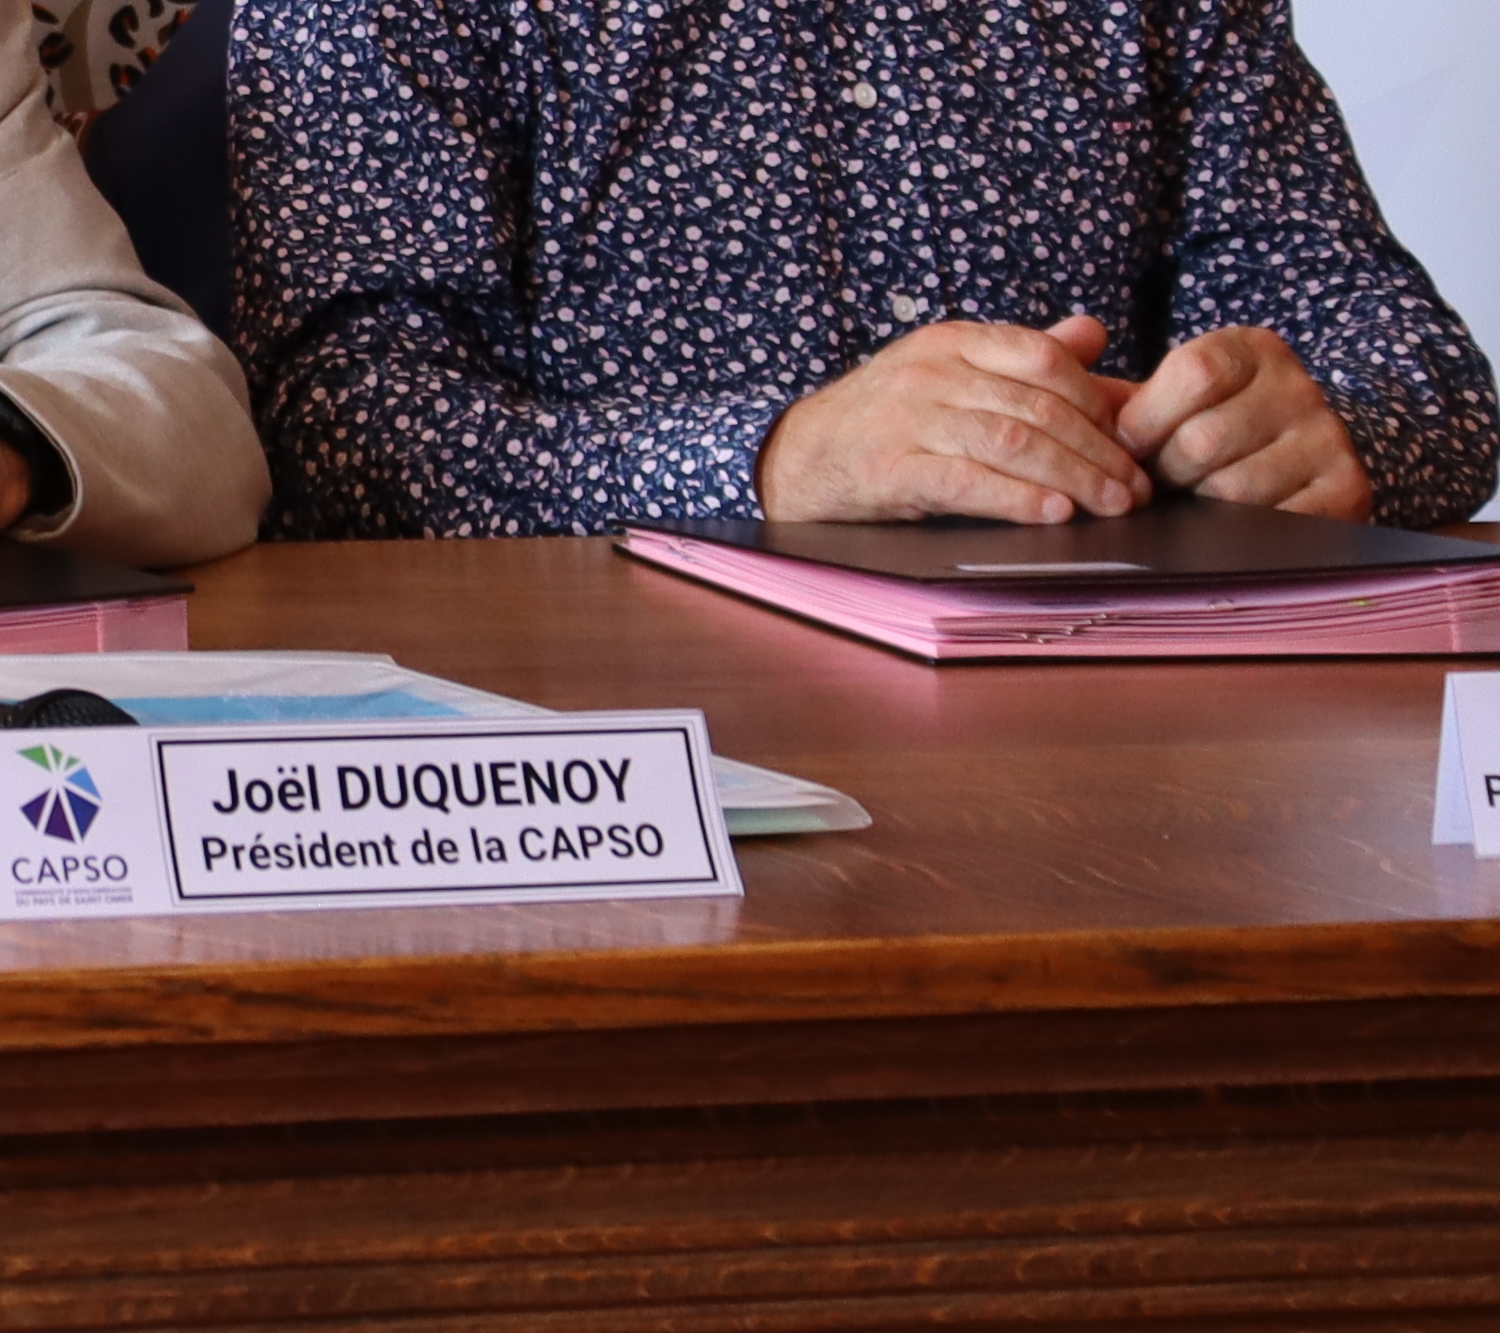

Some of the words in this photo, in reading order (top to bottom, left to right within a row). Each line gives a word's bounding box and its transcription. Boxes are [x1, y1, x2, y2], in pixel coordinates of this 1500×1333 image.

[212, 764, 321, 814] Joël
[336, 758, 632, 814] DUQUENOY
[11, 854, 129, 885] CAPSO
[200, 832, 400, 872] Président
[410, 829, 460, 865] de
[470, 827, 508, 864] la
[518, 822, 665, 863] CAPSO
